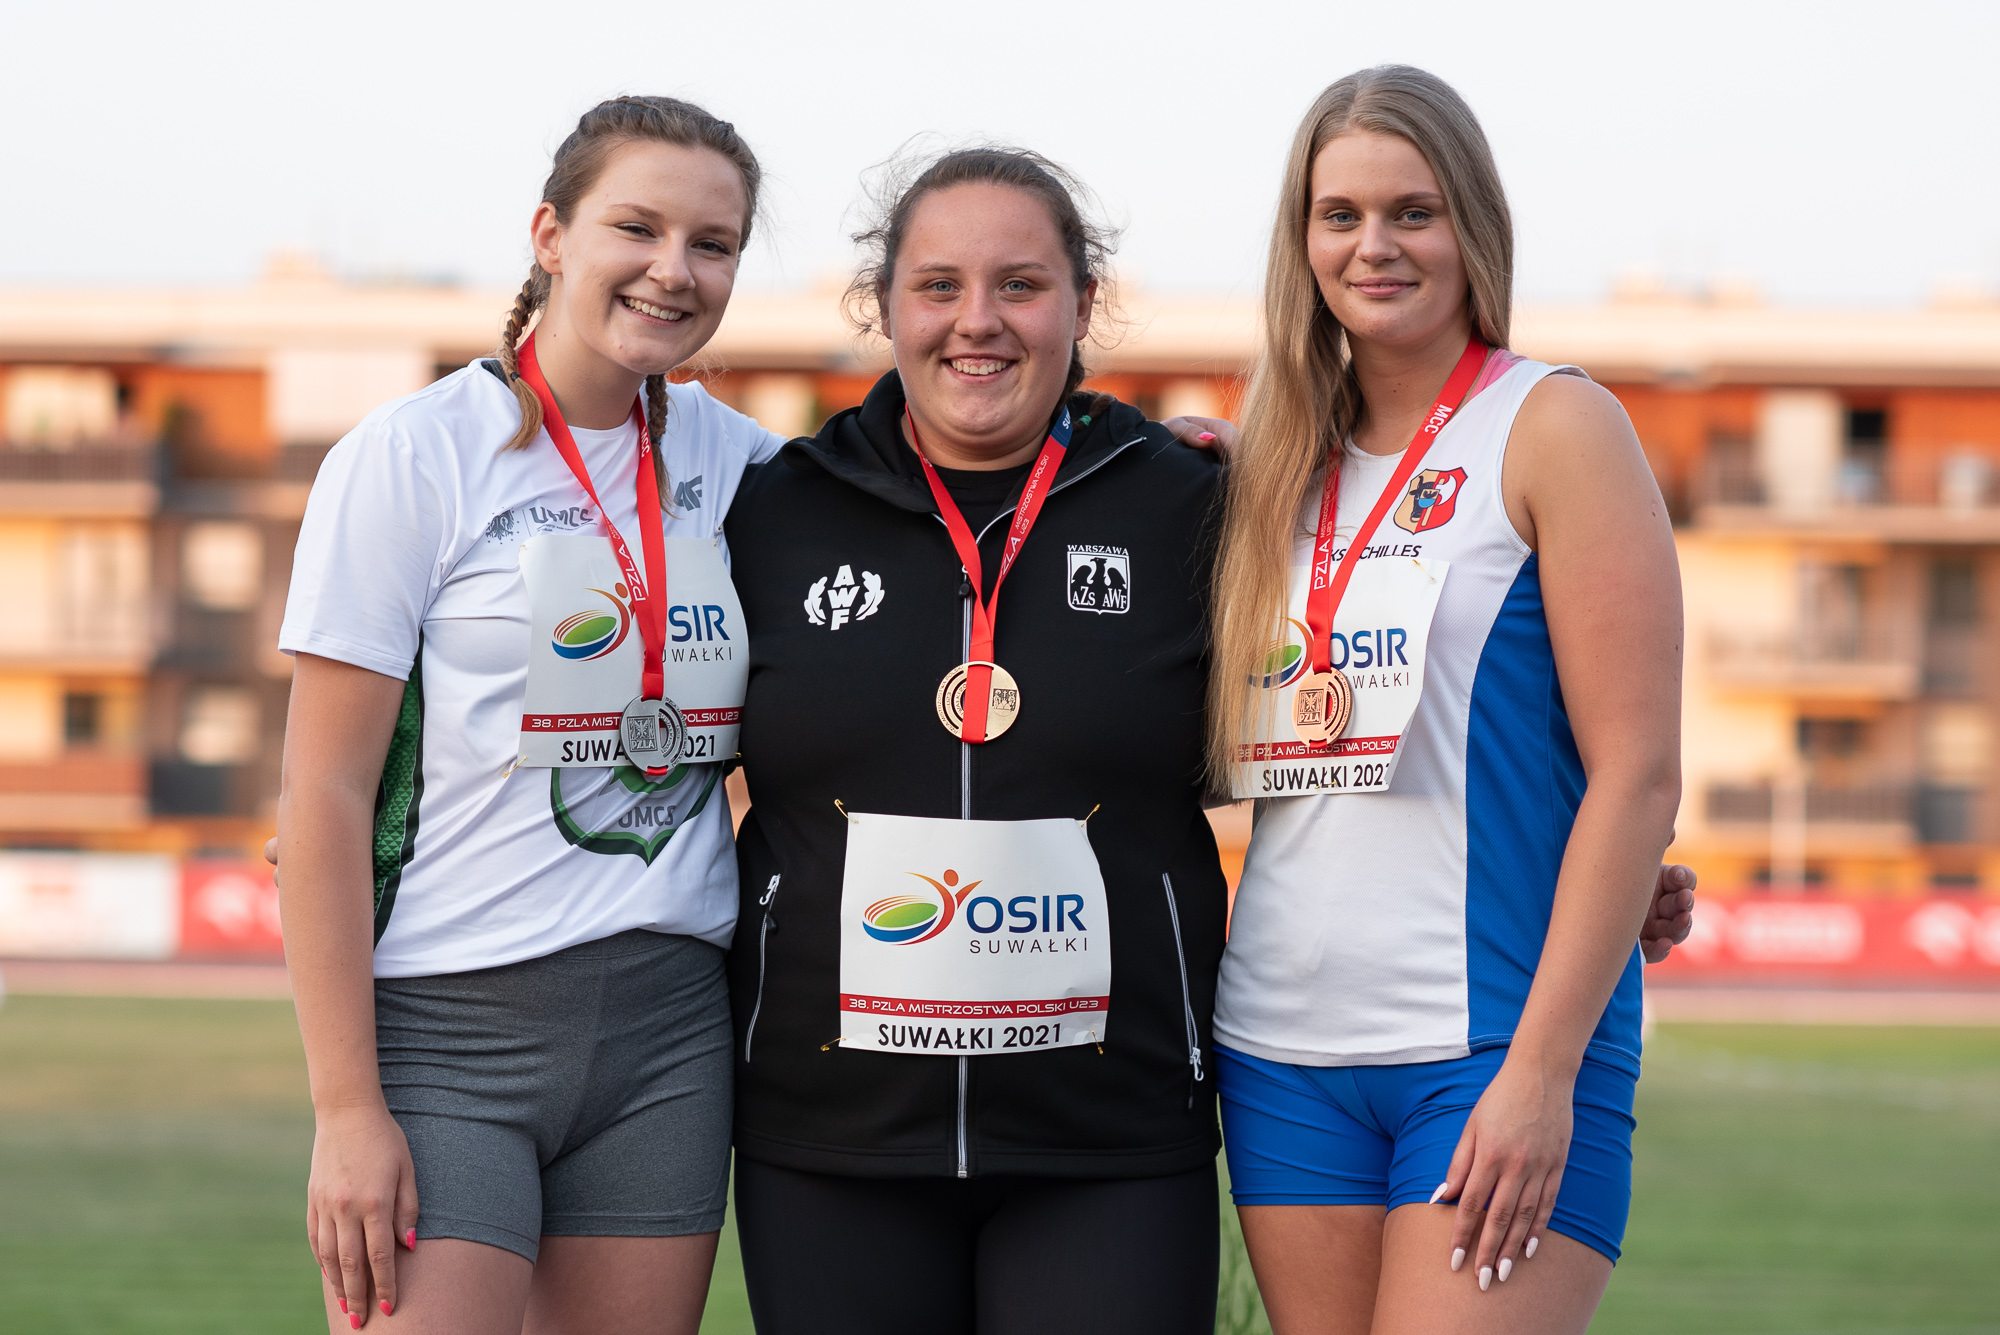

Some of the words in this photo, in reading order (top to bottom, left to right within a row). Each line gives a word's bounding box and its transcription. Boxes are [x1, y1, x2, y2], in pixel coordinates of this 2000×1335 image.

[1424, 404, 1454, 434] MCC
[1015, 479, 1038, 530] MISTRZOSTWA
[1035, 454, 1050, 479] POLSKI
[529, 506, 594, 528] UMCS
[1019, 518, 1030, 535] U23
[1000, 536, 1022, 577] ZLA
[1067, 544, 1129, 556] WARSZAWA
[1359, 545, 1422, 560] CHILLES
[618, 543, 646, 602] PZLA
[1313, 538, 1331, 590] PZLA
[668, 605, 731, 643] SIR
[1330, 628, 1409, 670] OSIR
[1352, 671, 1409, 689] WAŁKI
[531, 718, 555, 728] 38.
[557, 718, 590, 728] PZLA
[720, 711, 739, 721] U23
[560, 739, 629, 763] SUWA
[1256, 746, 1284, 757] PZLA
[1361, 740, 1395, 751] POLSKI
[1262, 765, 1347, 792] SUWAŁKI
[1353, 762, 1390, 787] 202
[618, 805, 677, 828] UMCS
[966, 894, 1088, 934] OSIR
[969, 938, 1088, 954] SUWAŁKI
[849, 998, 870, 1010] 38.
[872, 1000, 906, 1013] PZLA
[908, 1003, 1014, 1015] MISTRZOSTWA
[1016, 1002, 1066, 1014] POLSKI
[1069, 1000, 1099, 1009] U23
[877, 1023, 993, 1050] SUWAŁKI
[1002, 1022, 1061, 1048] 2021
